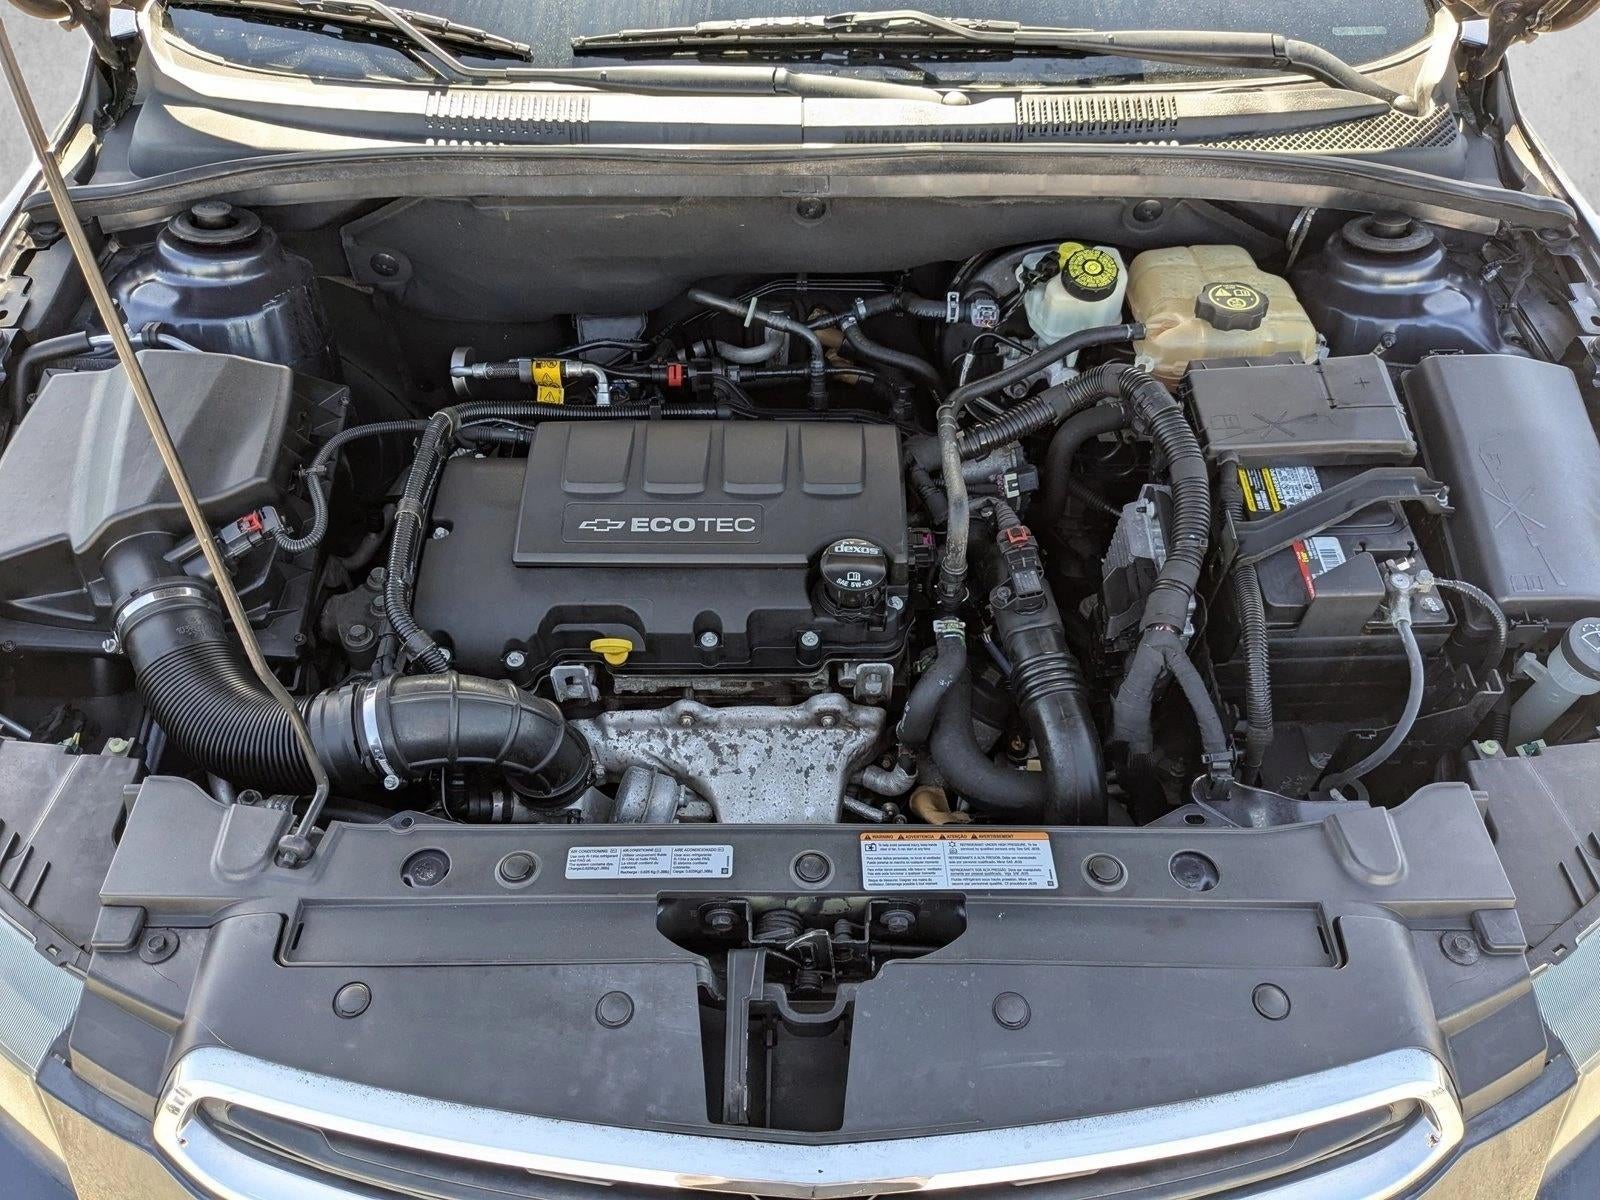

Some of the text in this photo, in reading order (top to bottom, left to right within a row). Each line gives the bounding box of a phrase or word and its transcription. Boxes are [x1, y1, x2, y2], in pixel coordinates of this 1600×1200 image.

[630, 517, 756, 532] ECOTEC
[835, 544, 880, 554] dexos
[836, 578, 872, 587] SAE 5W-30
